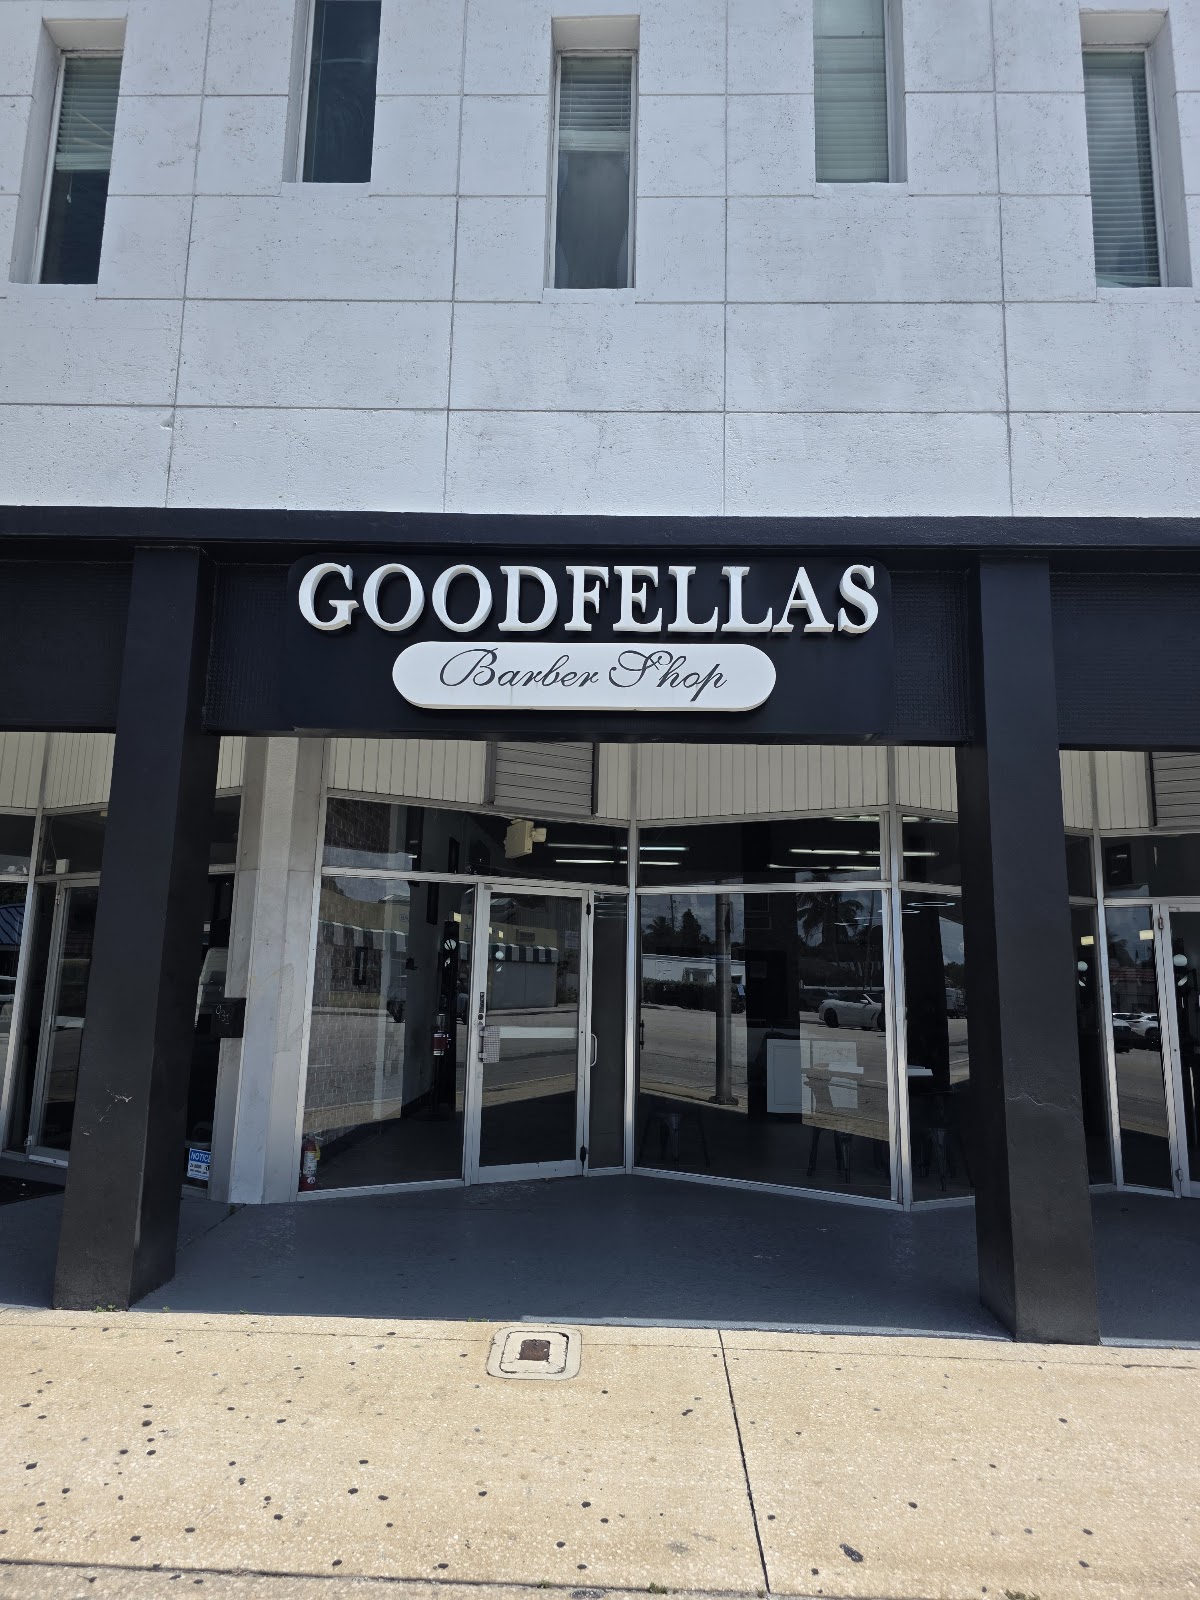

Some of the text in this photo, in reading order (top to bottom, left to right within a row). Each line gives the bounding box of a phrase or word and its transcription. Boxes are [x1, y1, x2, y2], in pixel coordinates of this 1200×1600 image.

[298, 562, 879, 634] GOODFELLAS
[439, 647, 727, 702] Barber Shop
